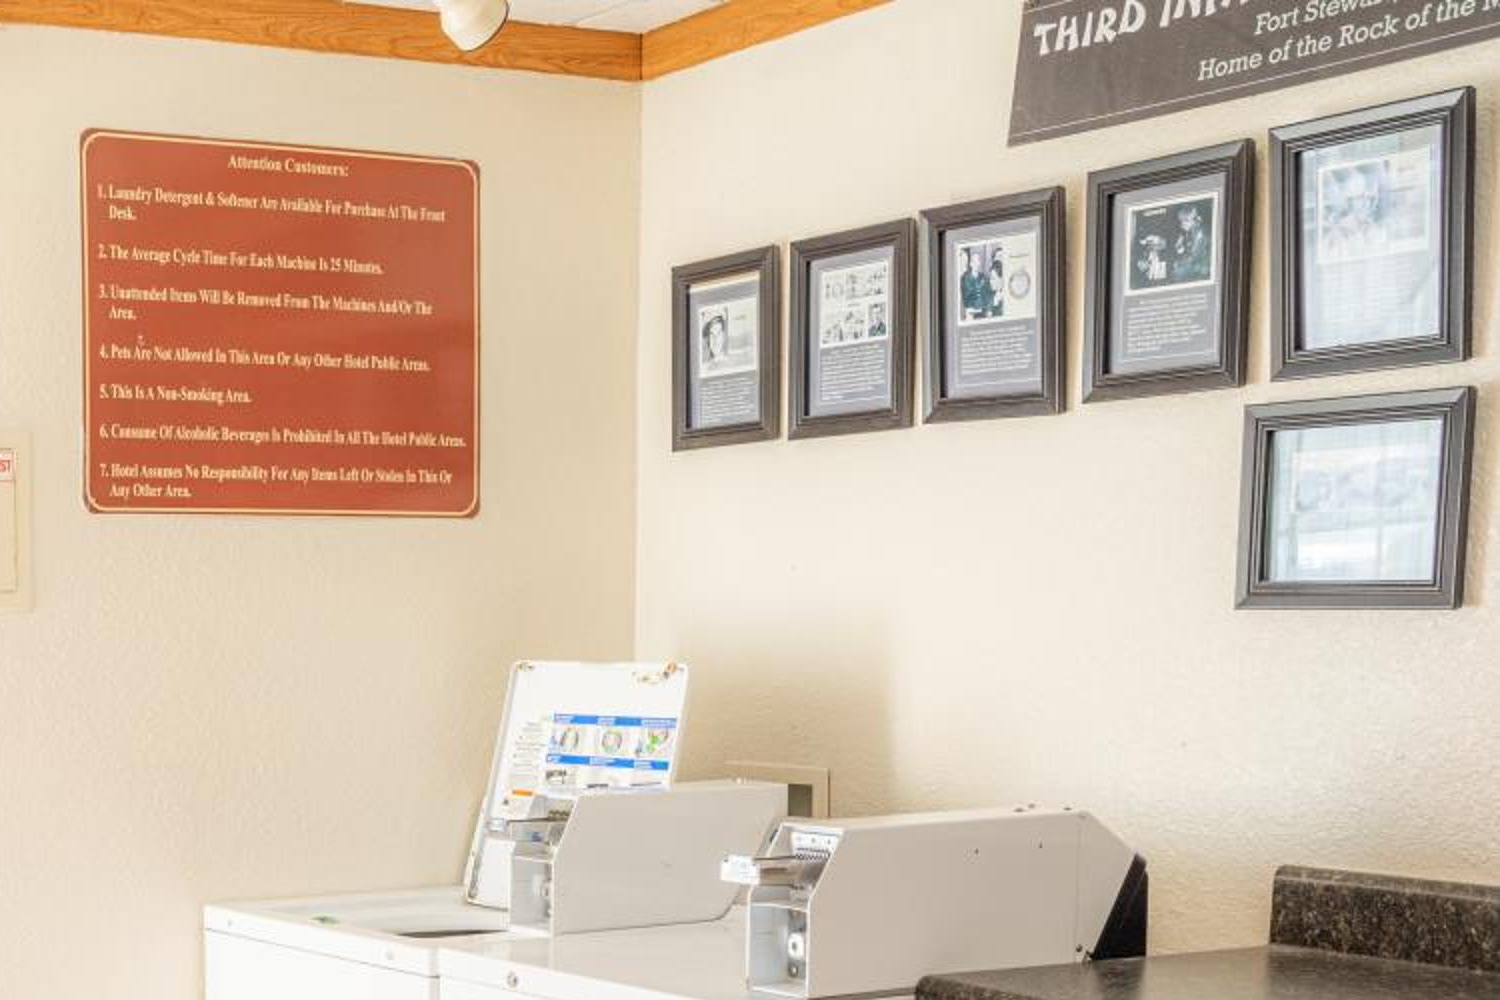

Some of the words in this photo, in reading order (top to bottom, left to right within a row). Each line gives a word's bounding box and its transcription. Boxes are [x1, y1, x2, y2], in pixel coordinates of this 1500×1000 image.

[1033, 0, 1147, 56] THIRD
[1254, 8, 1299, 35] Fort
[1303, 0, 1397, 22] Stew
[1197, 48, 1262, 81] Home
[1268, 36, 1294, 64] of
[1297, 33, 1332, 58] the
[1337, 16, 1401, 47] Rock
[1405, 4, 1432, 30] of
[1435, 0, 1475, 23] the
[228, 155, 282, 172] Attention
[285, 158, 349, 177] Customers:
[109, 184, 151, 204] Laundry
[155, 187, 203, 207] Detergent
[205, 192, 214, 206] &
[217, 192, 258, 209] Softener
[260, 196, 277, 210] Are
[280, 197, 323, 213] Available
[325, 200, 342, 214] For
[344, 201, 385, 217] Purchase
[388, 203, 398, 219] At
[400, 205, 417, 221] The
[420, 207, 445, 222] Front
[109, 205, 137, 220] Desk.
[110, 245, 128, 259] The
[132, 246, 170, 264] Average
[173, 248, 200, 266] Cycle
[202, 250, 228, 265] Time
[229, 252, 247, 266] For
[250, 253, 273, 268] Each
[277, 255, 318, 271] Machine
[319, 257, 328, 270] Is
[330, 257, 341, 272] 25
[111, 284, 167, 301] Unattended
[169, 287, 197, 302] Items
[199, 289, 221, 304] Will
[222, 290, 235, 305] Be
[237, 291, 281, 307] Removed
[284, 293, 310, 308] From
[312, 295, 331, 310] The
[415, 300, 432, 315] The
[111, 344, 131, 359] Pets
[134, 346, 152, 360] Are
[154, 346, 172, 361] Not
[174, 347, 213, 363] Allowed
[215, 349, 227, 363] In
[228, 349, 250, 364] This
[252, 350, 275, 365] Area
[277, 352, 291, 365] Or
[292, 353, 311, 369] Any
[314, 353, 343, 367] Other
[344, 354, 370, 369] Hotel
[371, 355, 400, 370] Public
[110, 384, 133, 399] This
[135, 384, 145, 399] Is
[146, 386, 154, 399] A
[157, 385, 223, 405] Non-Smoking
[111, 424, 157, 439] Consume
[159, 425, 173, 439] Of
[175, 426, 220, 441] Alcoholic
[222, 427, 269, 445] Beverages
[271, 427, 281, 442] Is
[283, 428, 331, 444] Prohibited
[333, 429, 344, 444] In
[347, 430, 361, 445] All
[362, 430, 380, 445] The
[381, 431, 407, 445] Hotel
[408, 431, 436, 447] Public
[111, 463, 139, 478] Hotel
[140, 464, 183, 478] Assumes
[185, 464, 199, 478] No
[201, 465, 268, 483] Responsibility
[271, 466, 288, 480] For
[290, 467, 309, 486] Any
[311, 467, 338, 481] Items
[339, 467, 359, 481] Left
[361, 468, 374, 482] Or
[406, 469, 417, 483] In
[418, 469, 438, 483] This
[439, 470, 452, 484] Or
[109, 484, 130, 500] Any
[132, 483, 162, 497] Other
